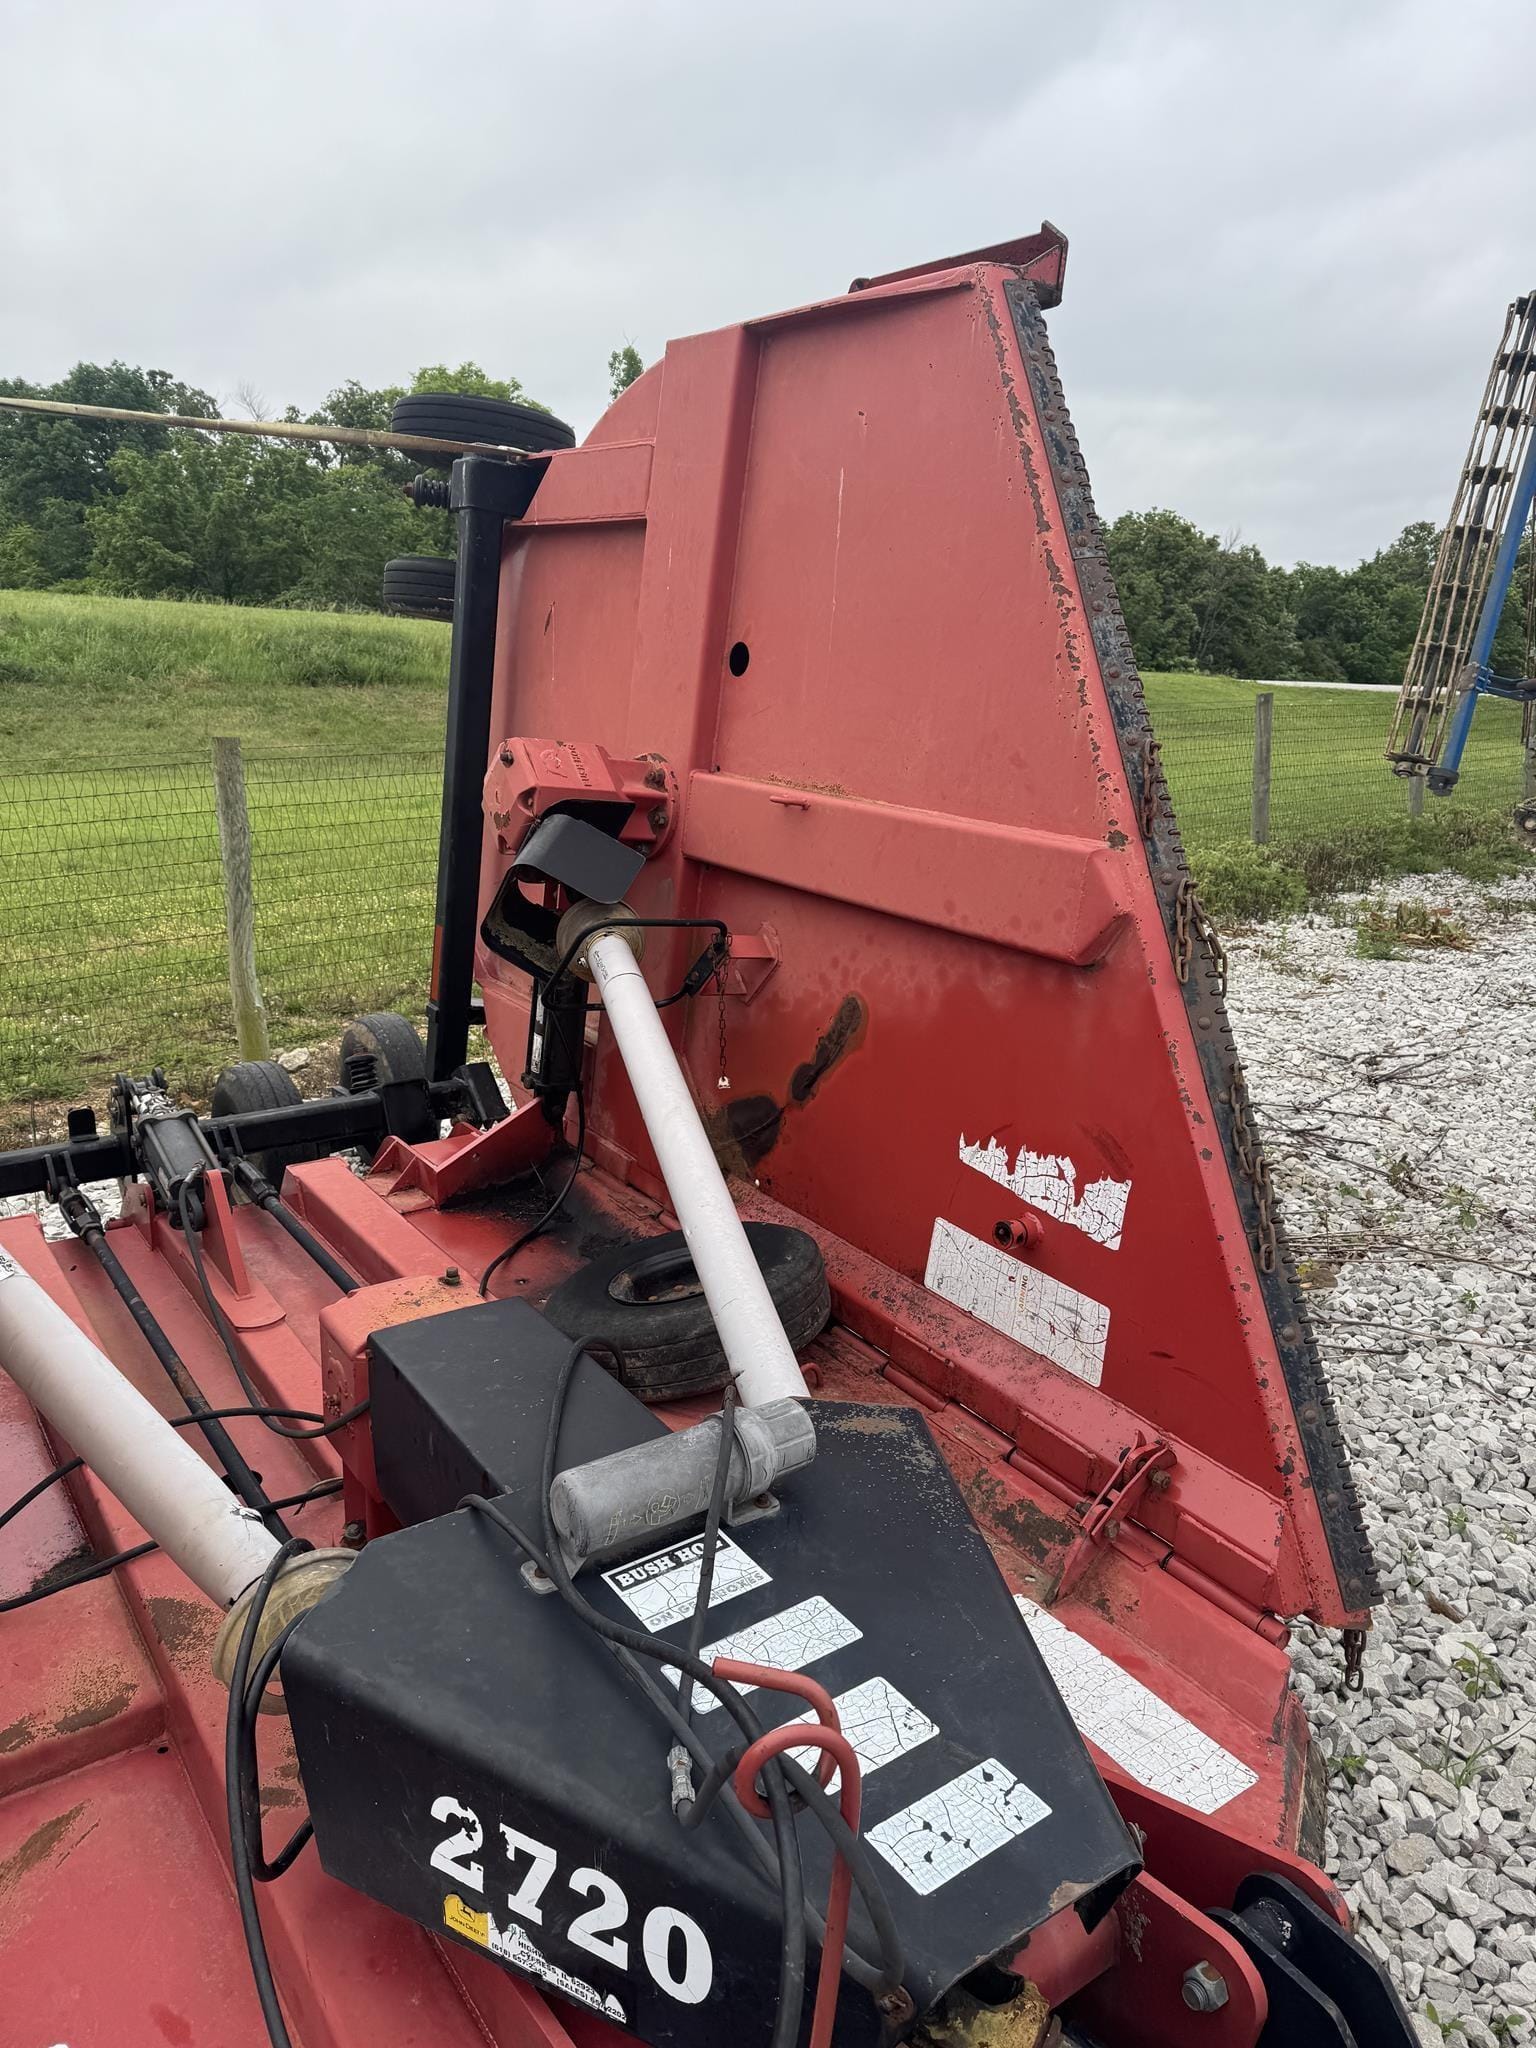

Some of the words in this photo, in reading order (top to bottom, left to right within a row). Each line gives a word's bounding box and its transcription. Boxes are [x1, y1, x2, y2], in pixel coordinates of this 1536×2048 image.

[1017, 1274, 1029, 1314] ARNING
[615, 1554, 676, 1587] BUSH
[650, 1610, 674, 1627] ON
[430, 1796, 713, 2004] 2720
[449, 1915, 466, 1927] JOHN
[556, 1977, 588, 2001] (SALES)
